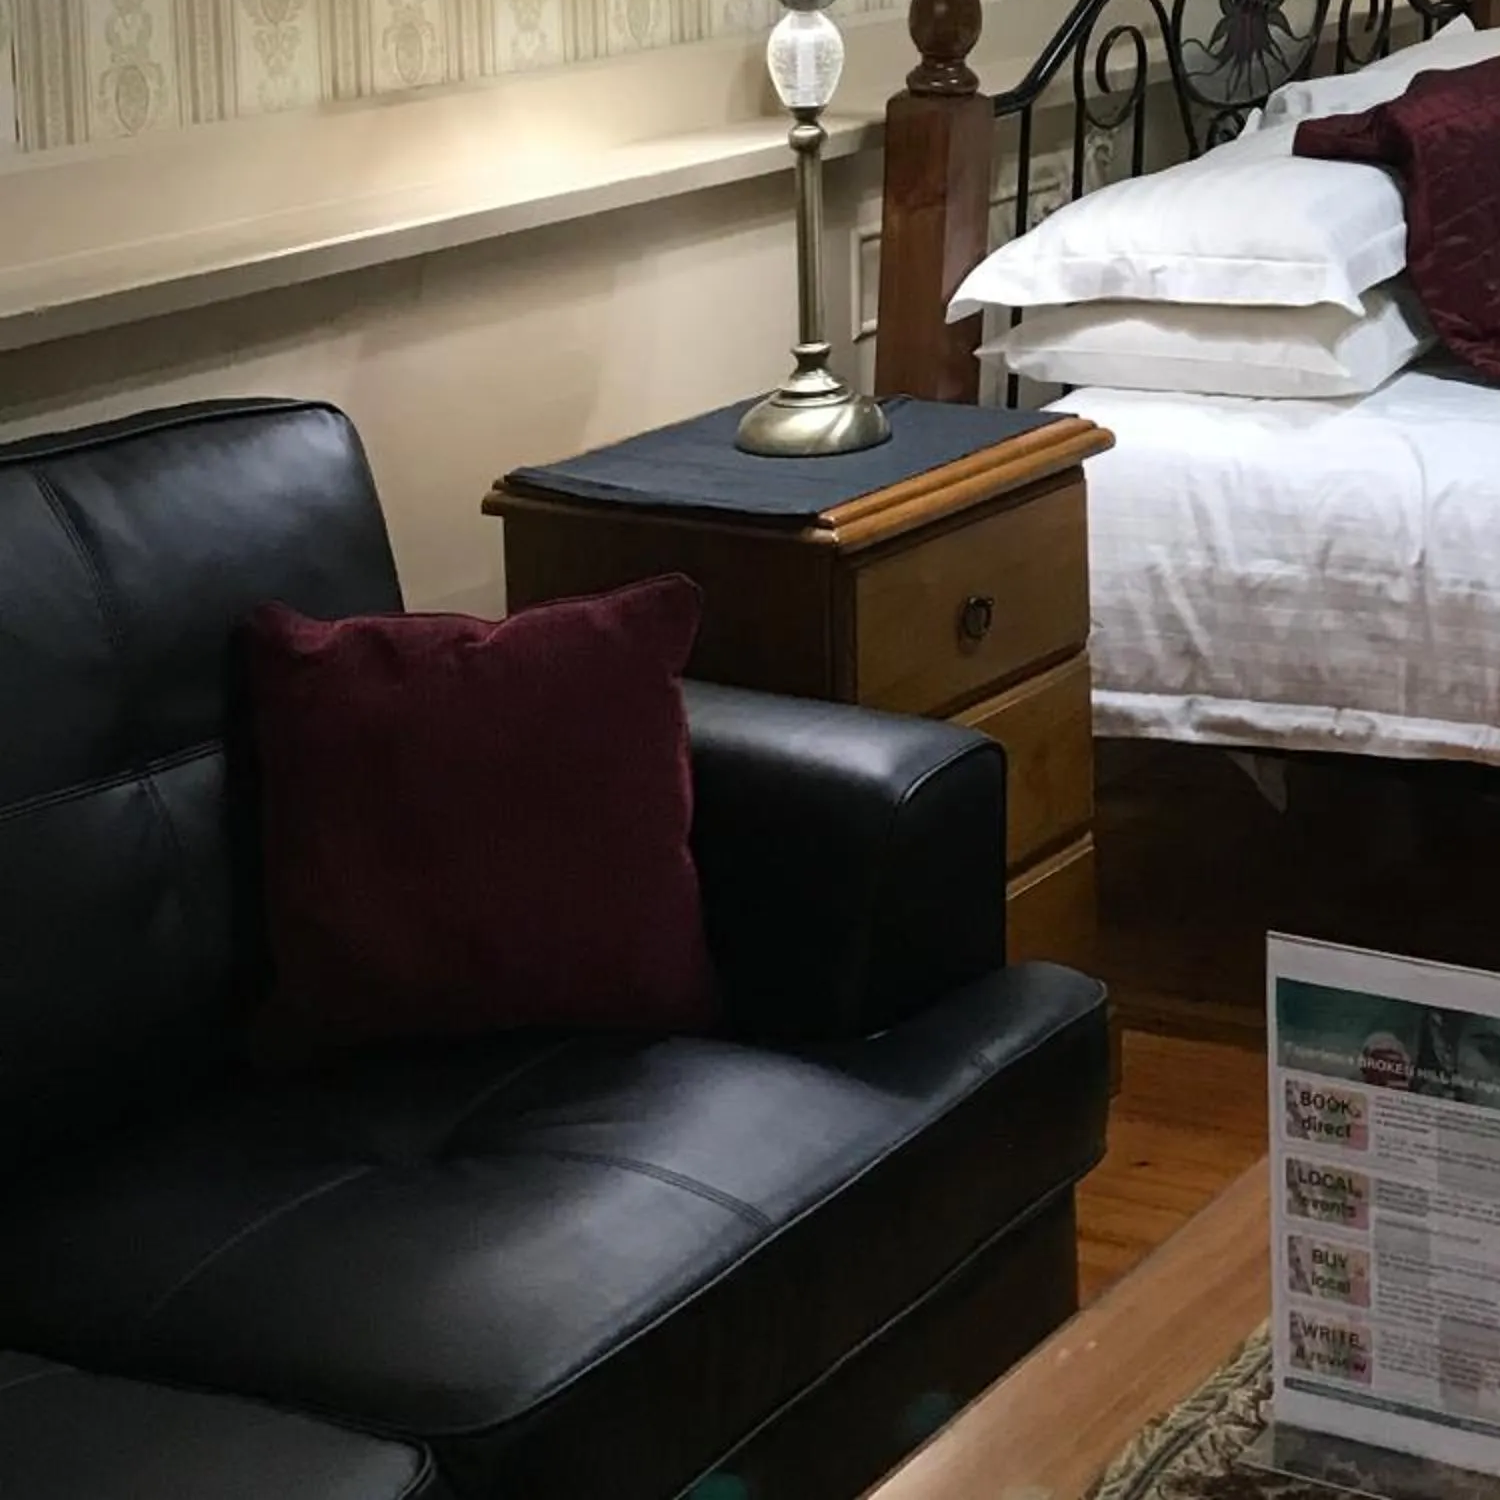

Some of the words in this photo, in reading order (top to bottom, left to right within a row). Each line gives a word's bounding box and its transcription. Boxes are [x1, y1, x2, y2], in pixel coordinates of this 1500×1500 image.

[1358, 1054, 1414, 1077] BROKEN
[1300, 1091, 1352, 1116] BOOK
[1301, 1115, 1352, 1138] direct
[1298, 1167, 1355, 1194] LOCAL
[1311, 1248, 1348, 1269] BUY
